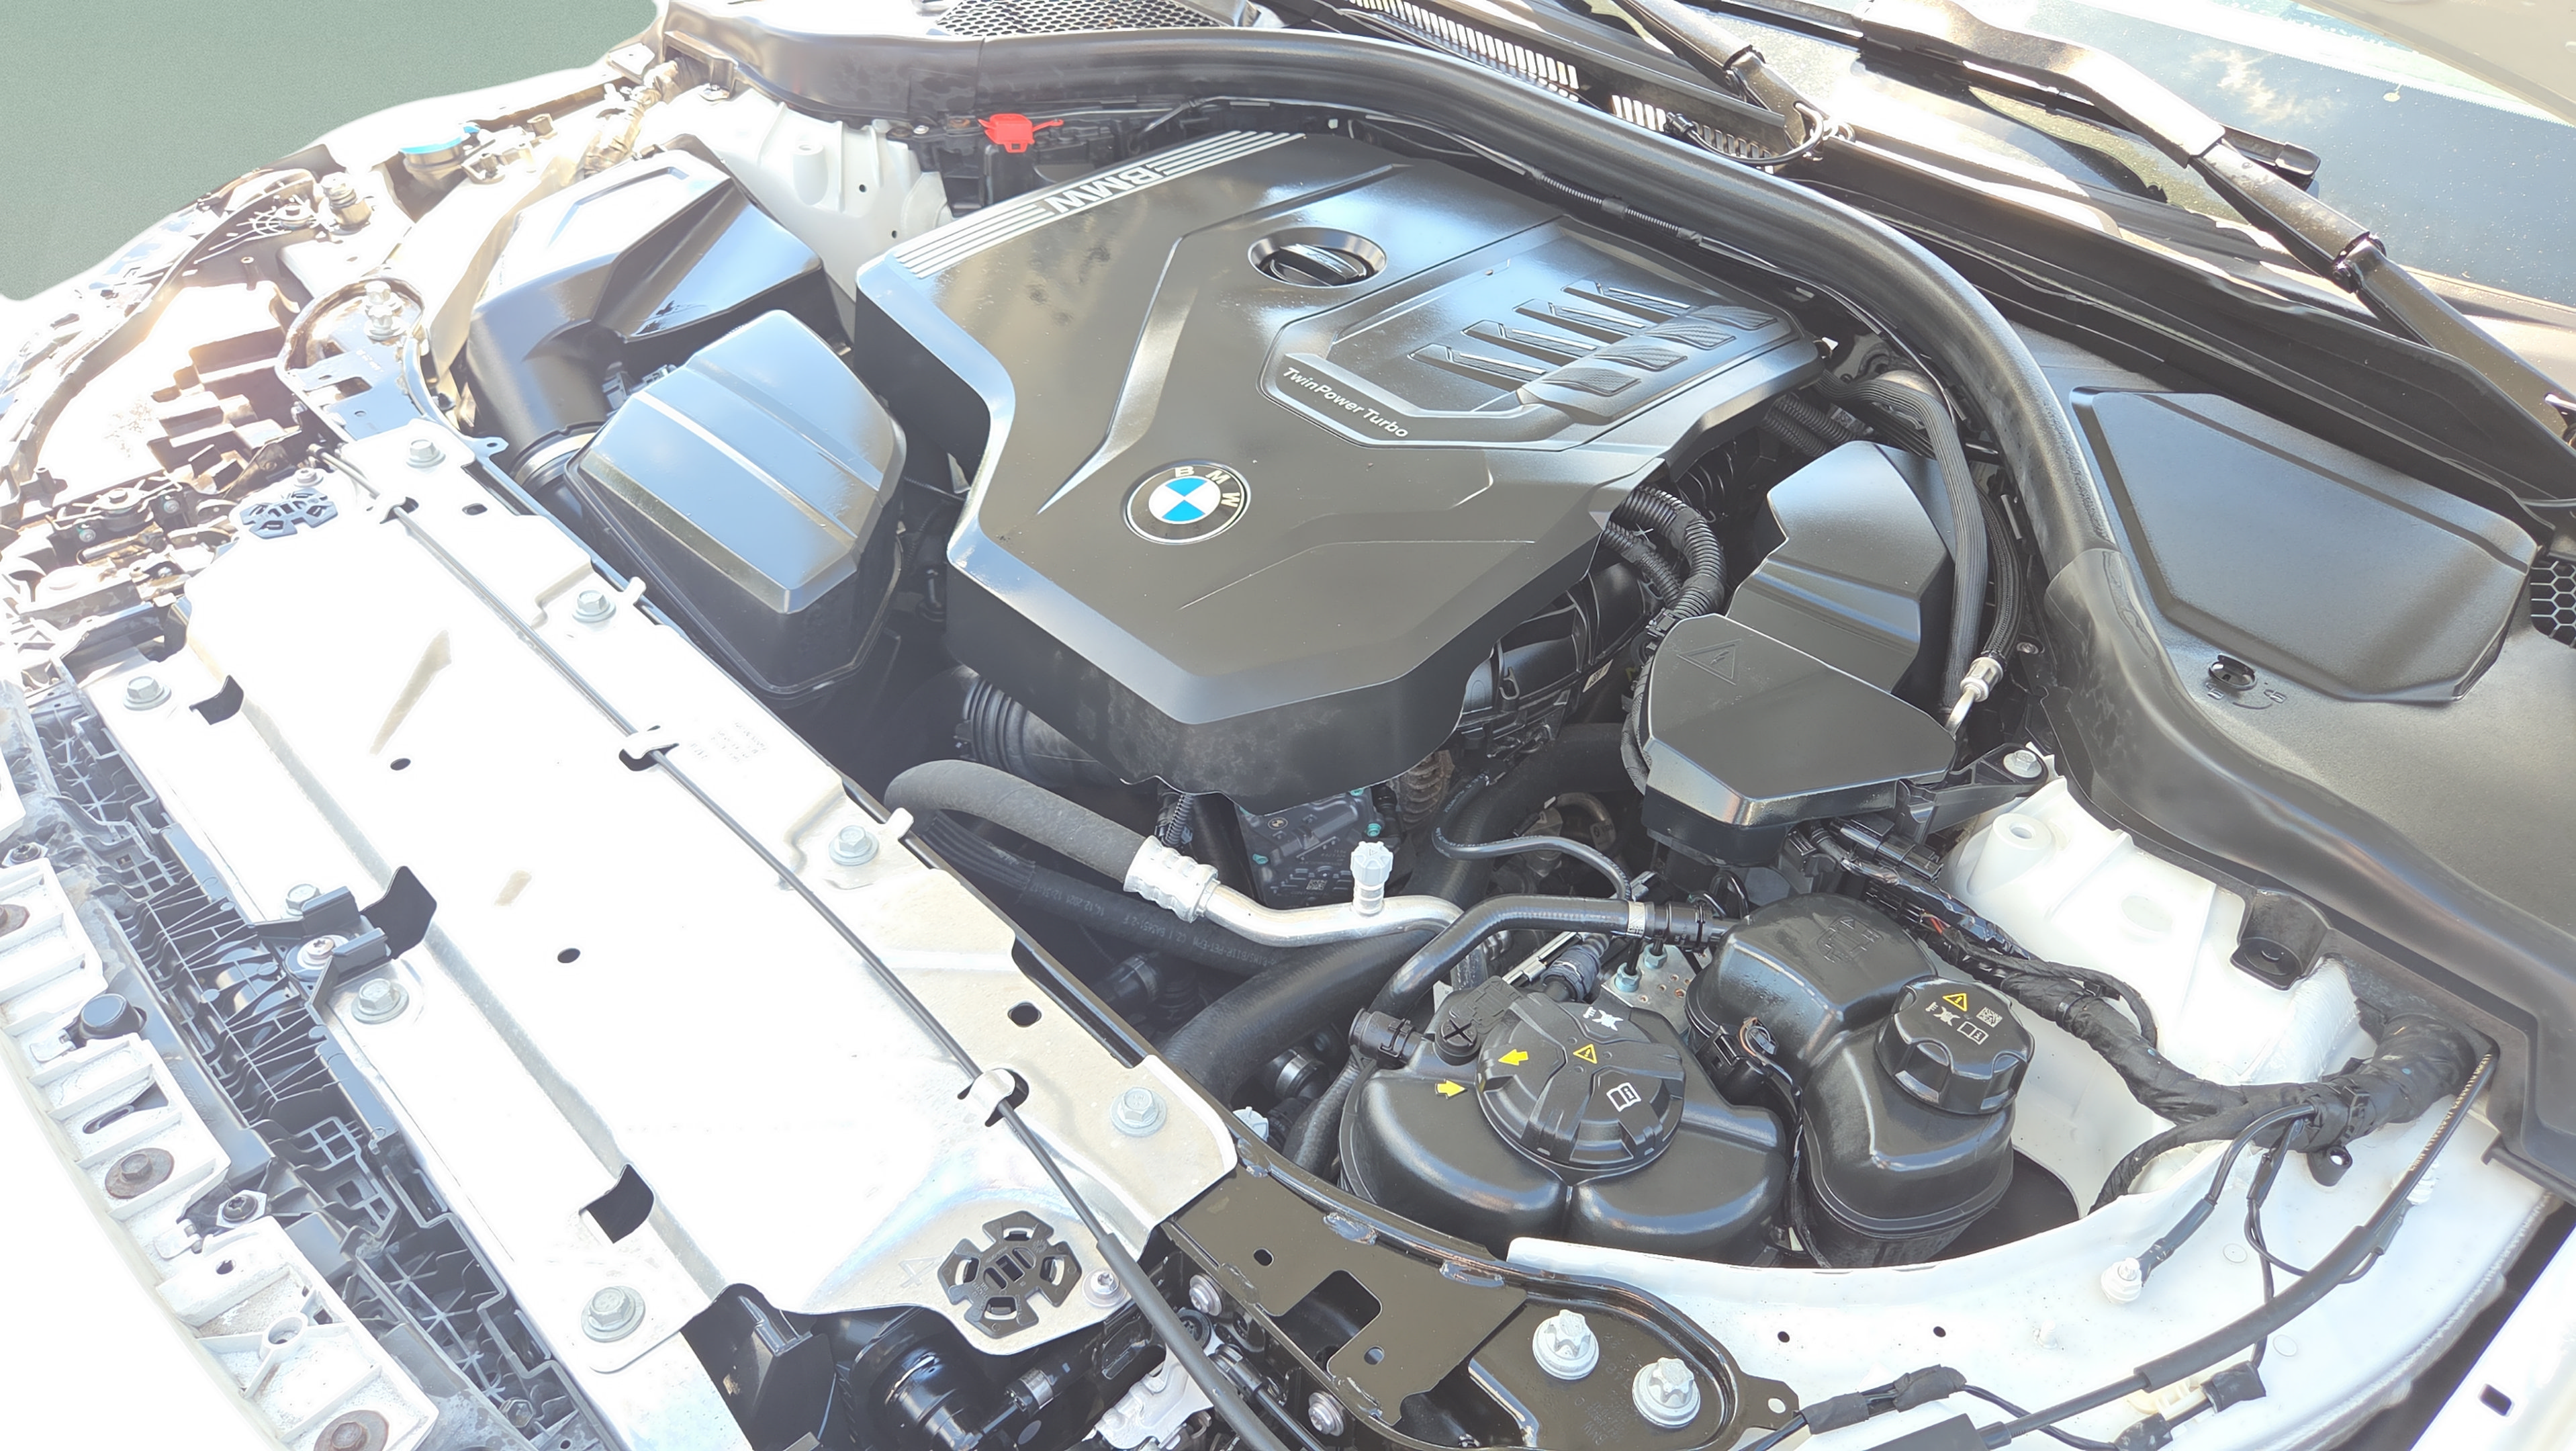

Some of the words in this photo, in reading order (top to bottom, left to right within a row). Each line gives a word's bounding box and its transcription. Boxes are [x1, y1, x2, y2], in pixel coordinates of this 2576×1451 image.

[1044, 167, 1164, 213] BMW
[1283, 367, 1365, 413] TwinPower
[1363, 408, 1408, 437] Turbo
[1175, 466, 1240, 508] BMW
